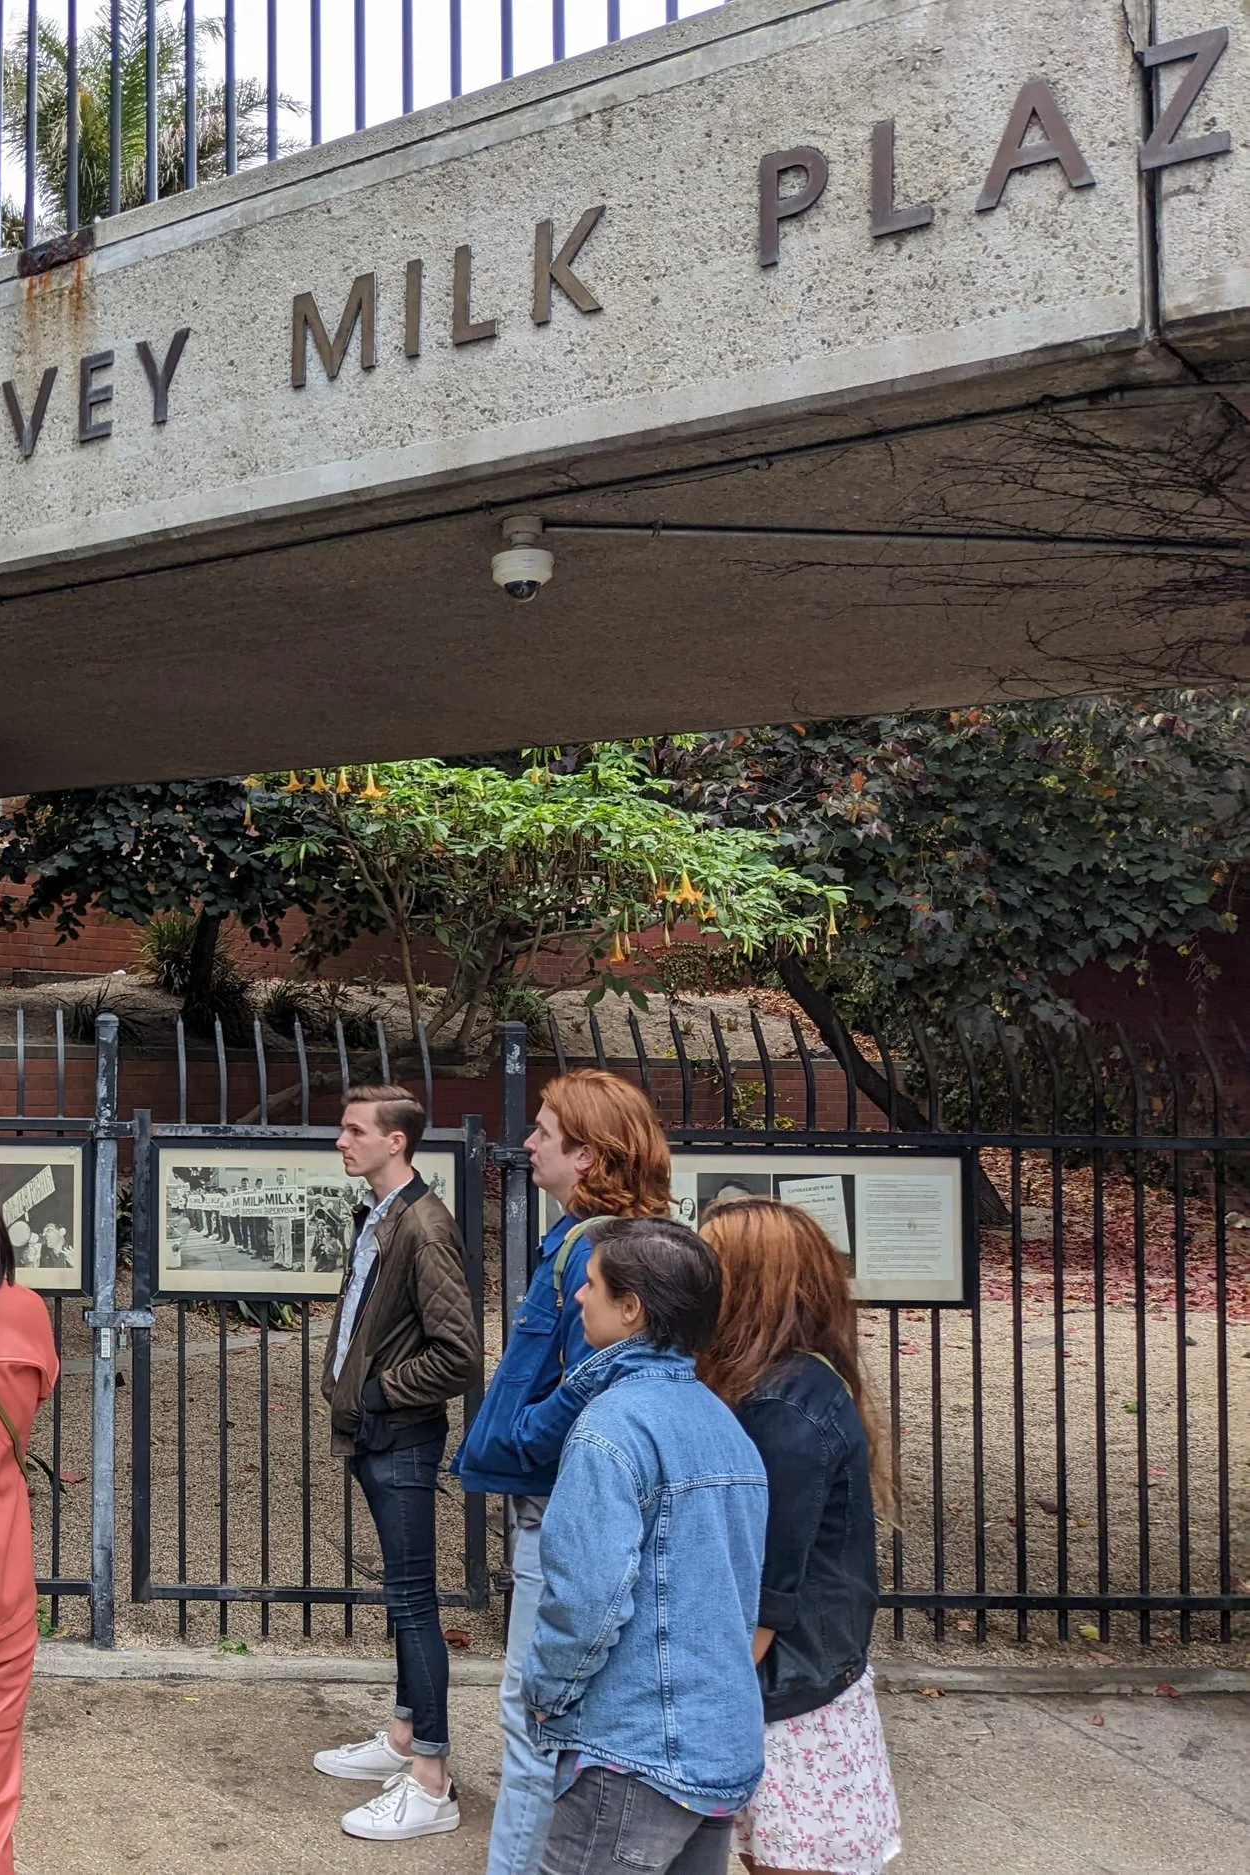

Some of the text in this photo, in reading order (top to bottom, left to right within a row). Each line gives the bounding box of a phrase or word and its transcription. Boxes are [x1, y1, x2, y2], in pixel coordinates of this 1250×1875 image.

[291, 205, 606, 388] MILK
[759, 26, 1232, 267] PLAZ
[265, 1193, 294, 1205] MILK
[264, 1206, 297, 1214] SUPERVISOR
